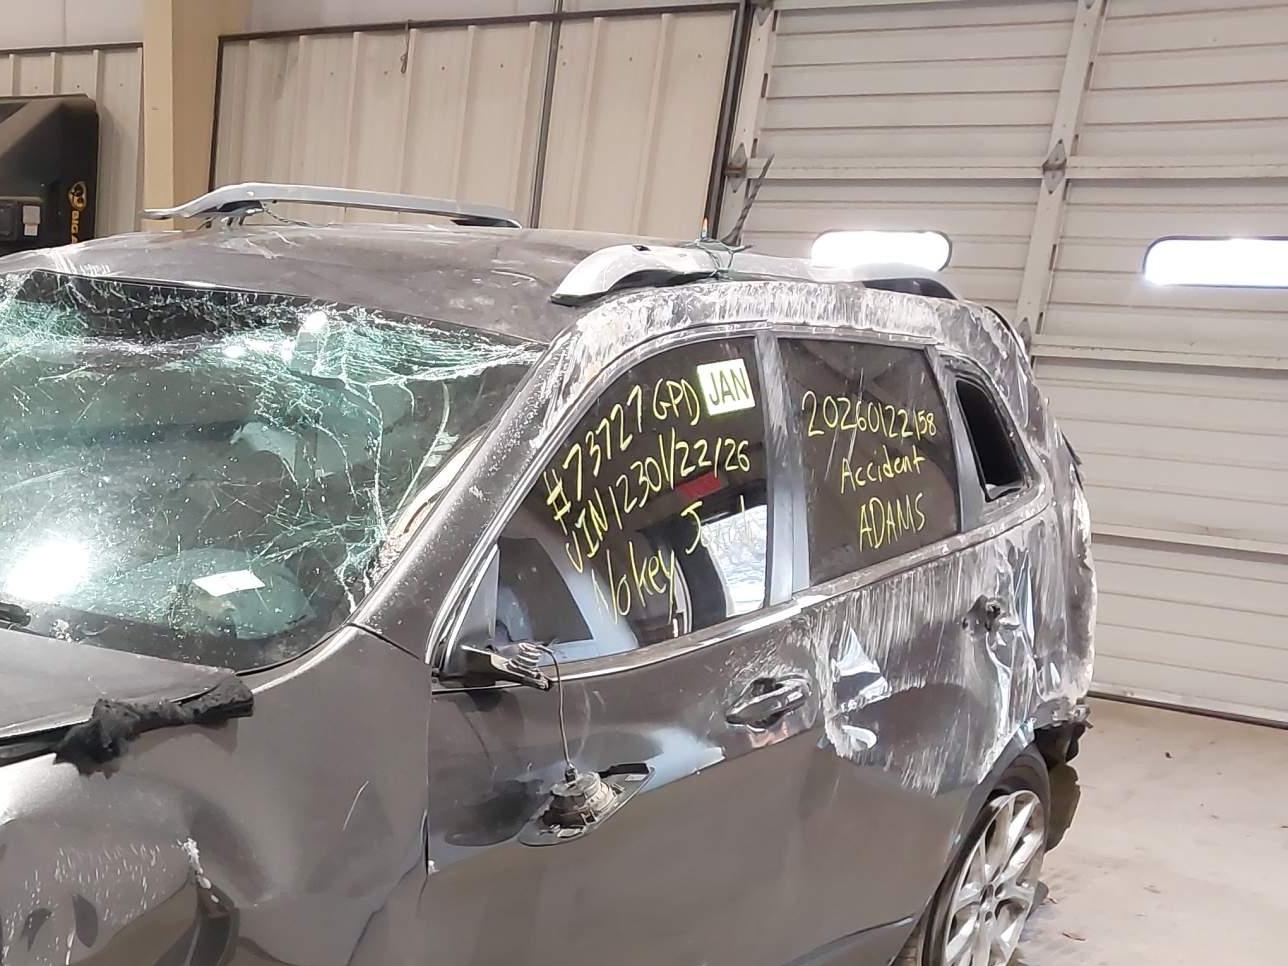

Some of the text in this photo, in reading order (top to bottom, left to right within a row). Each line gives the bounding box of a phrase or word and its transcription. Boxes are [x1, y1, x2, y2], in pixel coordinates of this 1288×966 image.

[708, 367, 750, 407] JAN
[543, 384, 642, 536] #73727
[652, 377, 700, 426] GPD
[840, 444, 926, 494] Accident
[859, 492, 926, 552] ADAMS
